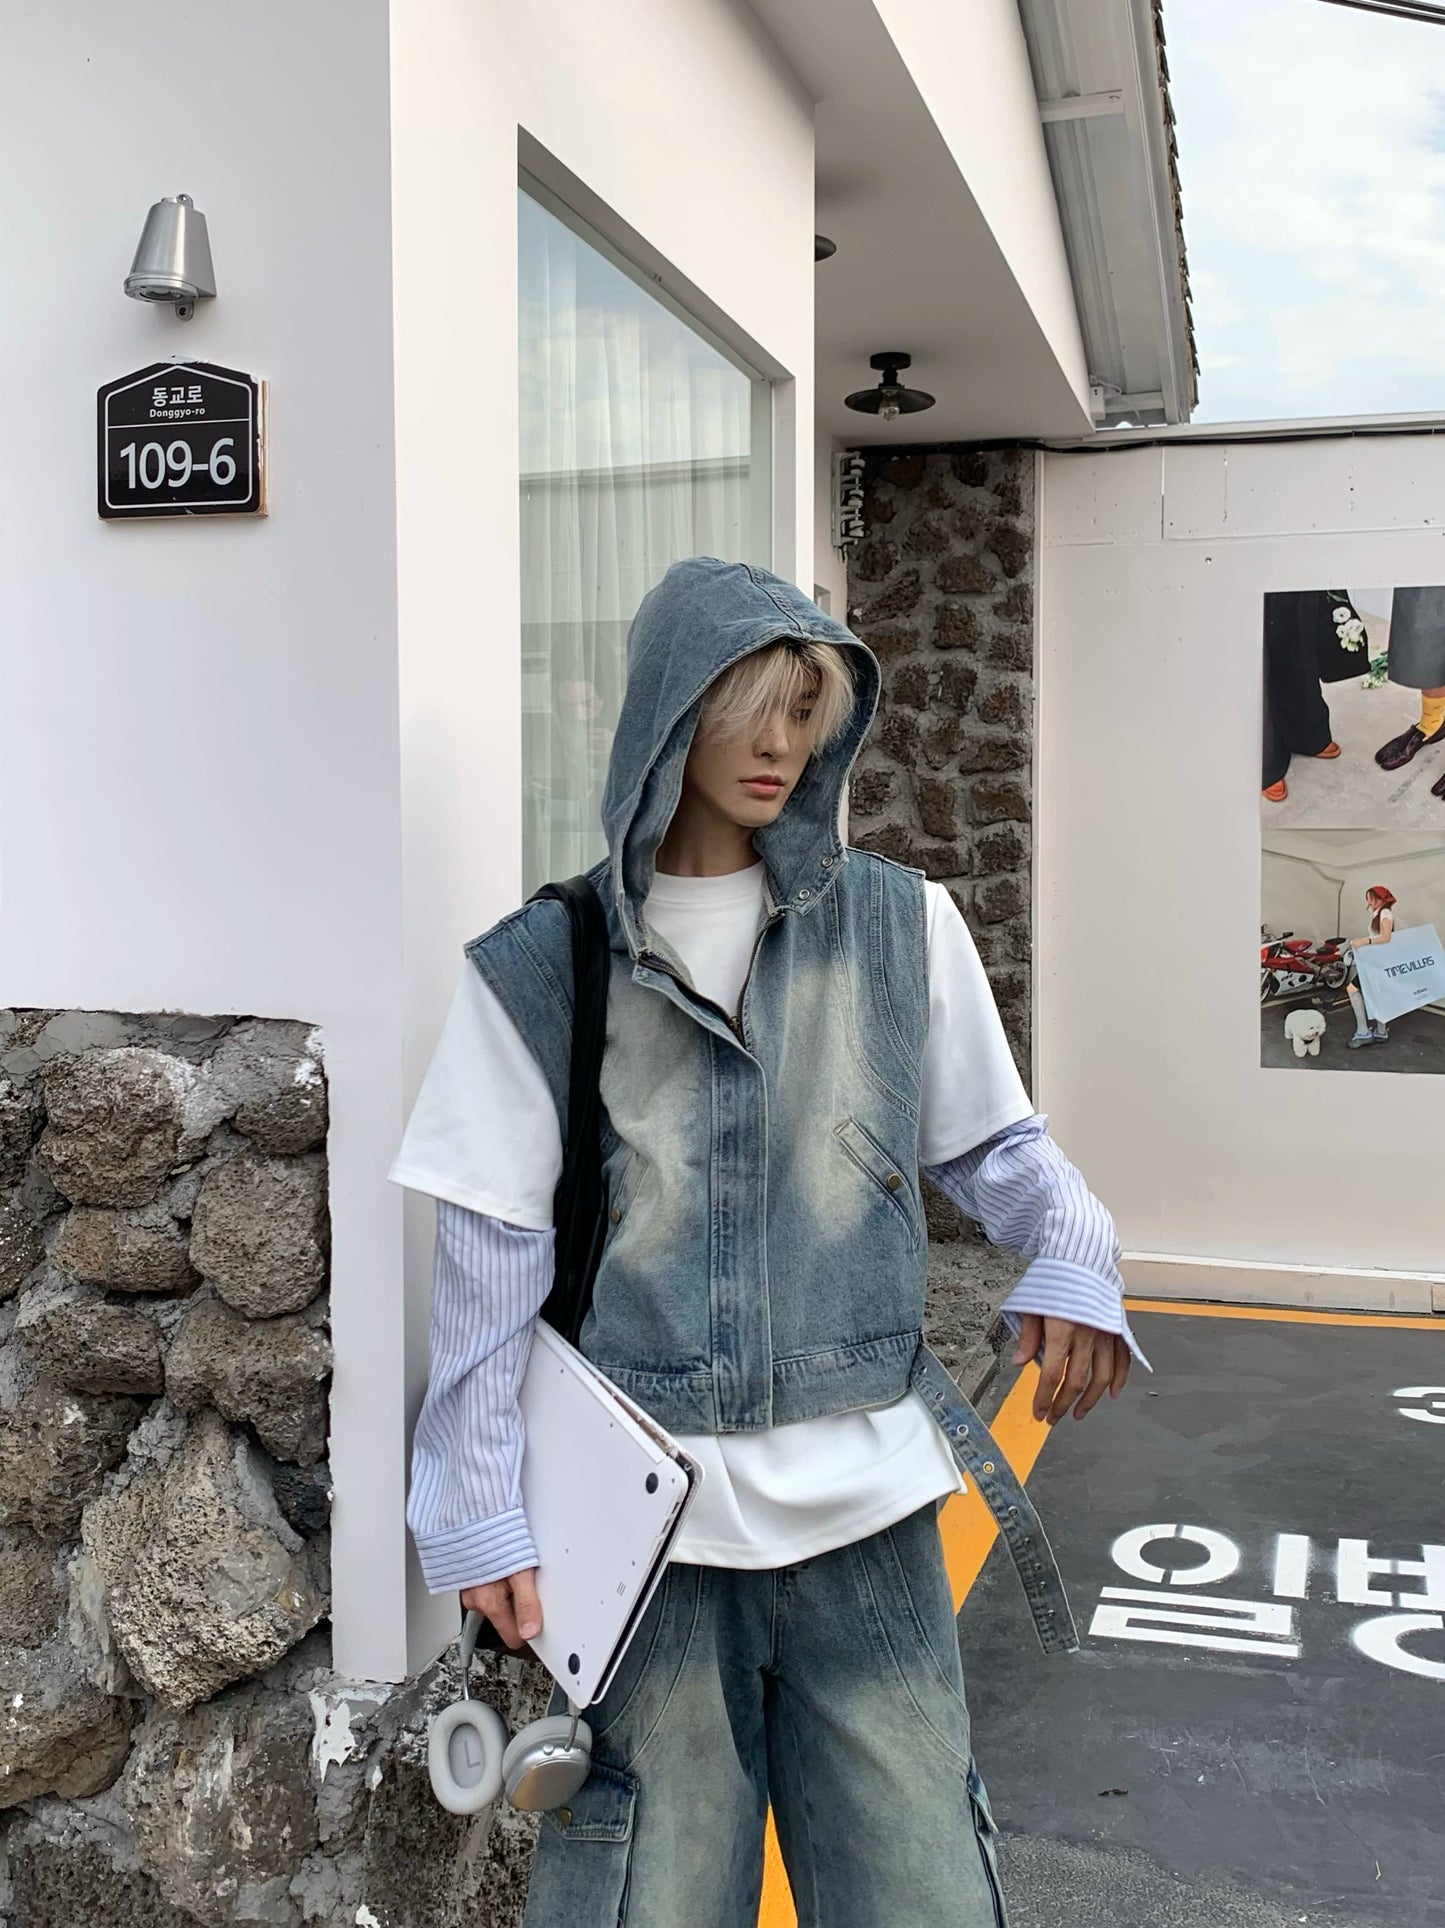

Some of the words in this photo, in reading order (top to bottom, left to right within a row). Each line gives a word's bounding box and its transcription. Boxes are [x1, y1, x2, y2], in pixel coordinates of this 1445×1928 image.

[152, 385, 203, 407] 동교로
[149, 407, 206, 419] Donggyo-ro
[120, 437, 237, 489] 109-6
